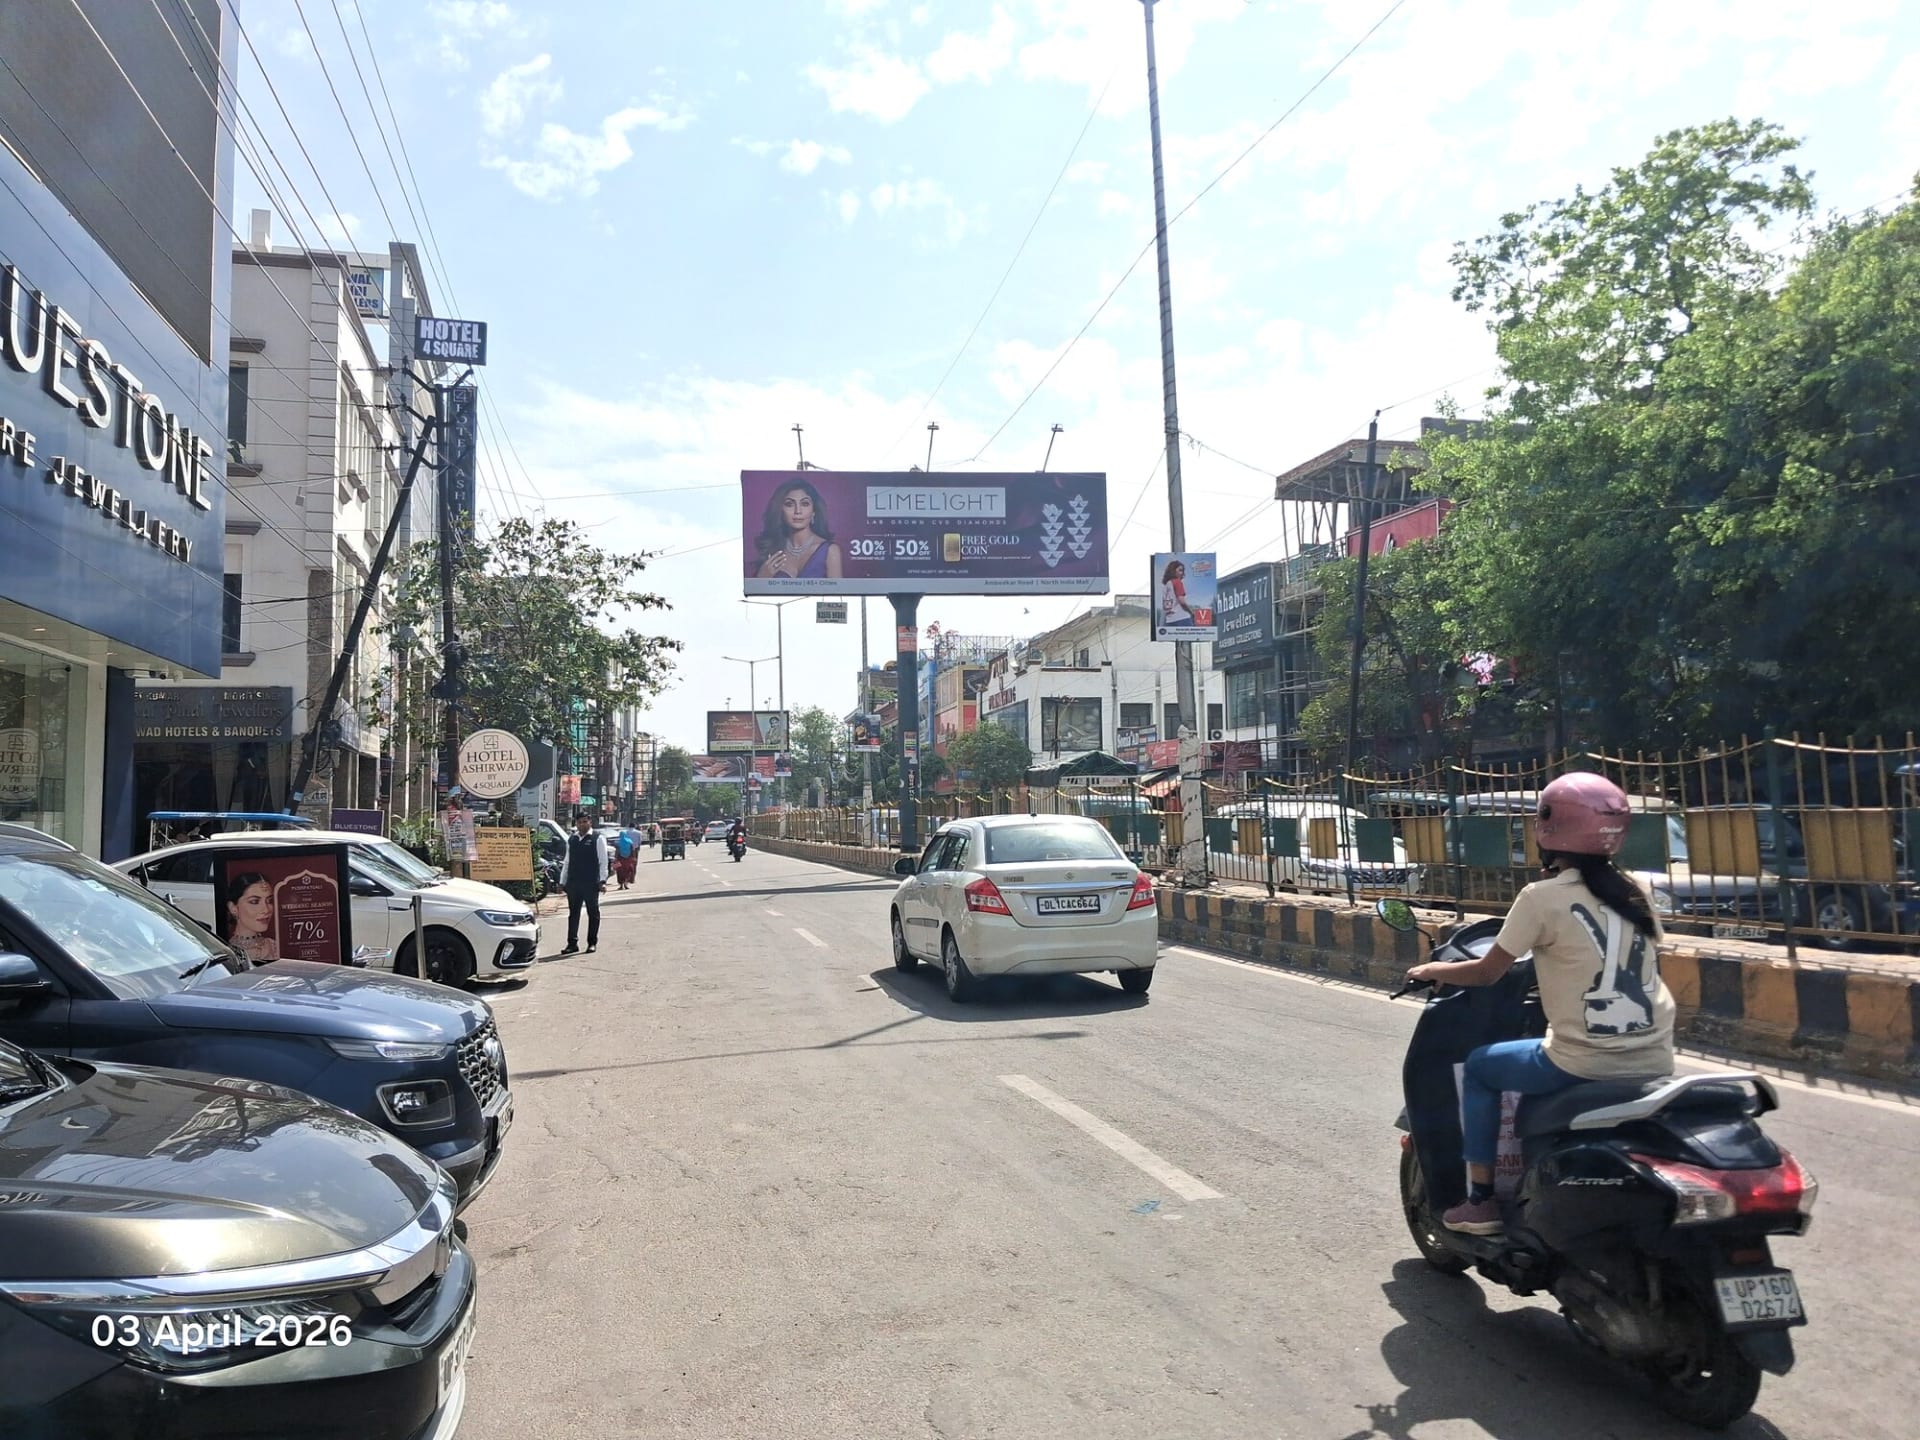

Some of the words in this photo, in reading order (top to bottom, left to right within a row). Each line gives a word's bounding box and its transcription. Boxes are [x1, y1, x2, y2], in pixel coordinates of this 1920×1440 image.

[420, 318, 482, 344] HOTEL
[423, 340, 431, 355] 4
[433, 341, 479, 359] SQUARE
[0, 265, 213, 511] UESTONE
[47, 455, 193, 563] JEWELLERY
[874, 492, 999, 511] LIMELIGHT
[850, 539, 885, 556] 30%
[895, 539, 929, 556] 50%
[961, 535, 987, 545] FREE
[988, 535, 1020, 545] GOLD
[1216, 588, 1250, 614] hhabra
[1252, 576, 1268, 602] 777
[1222, 612, 1257, 633] Jewellers
[165, 726, 208, 738] HOTELS
[211, 726, 220, 737] &
[466, 750, 517, 763] HOTEL
[461, 762, 524, 774] ASHIRWAD
[479, 780, 513, 790] SQUARE
[334, 823, 379, 832] BLUESTONE
[292, 920, 325, 941] 7%
